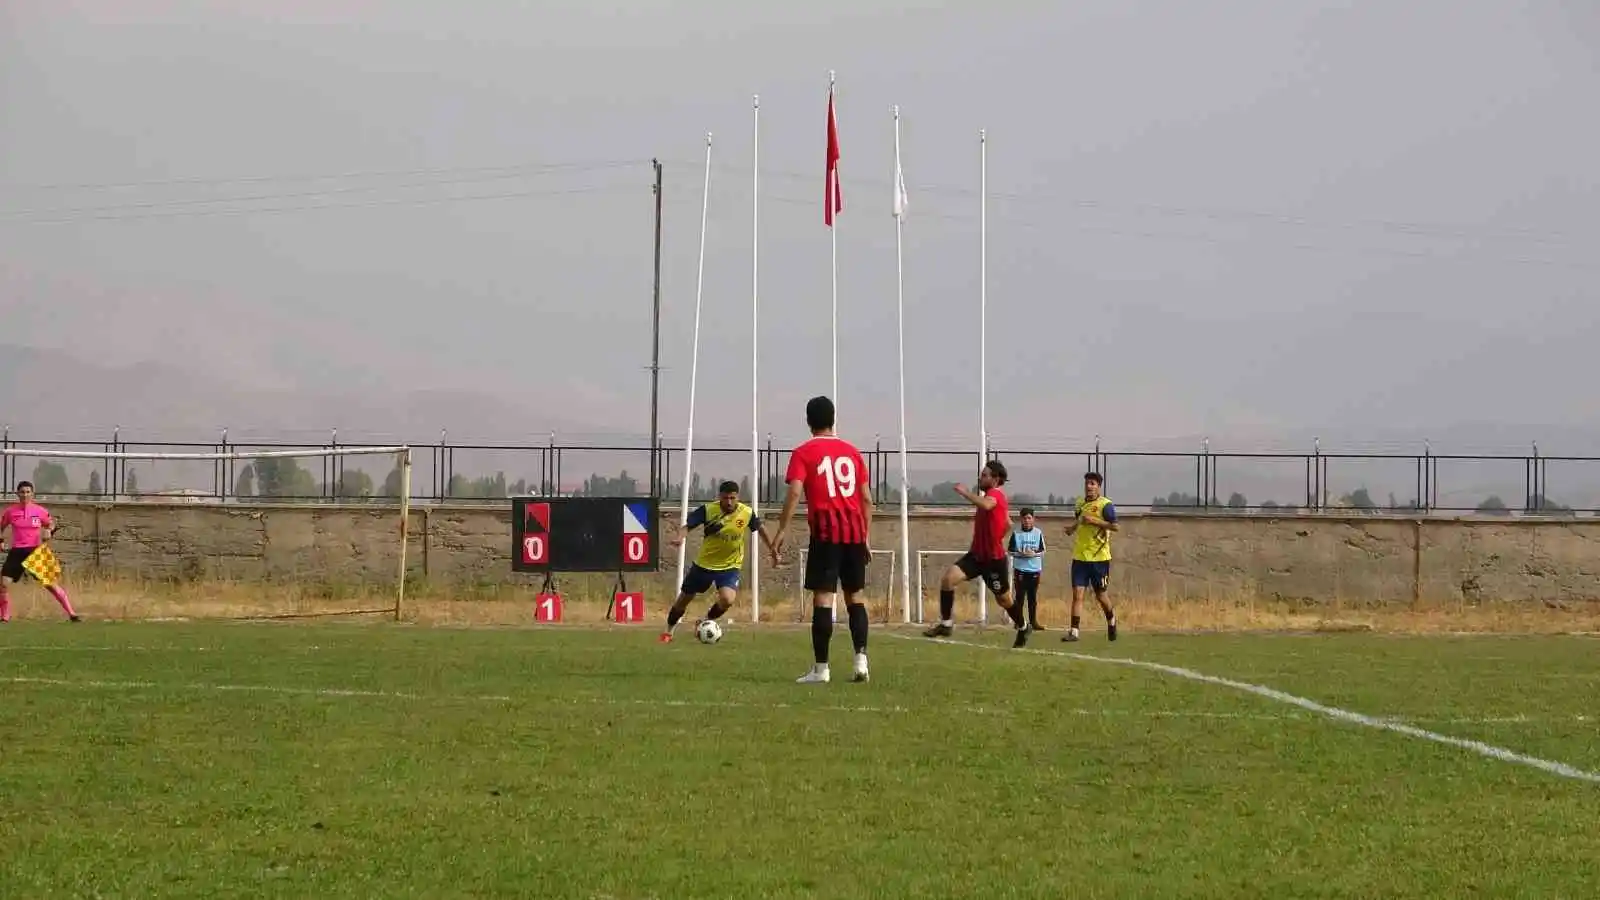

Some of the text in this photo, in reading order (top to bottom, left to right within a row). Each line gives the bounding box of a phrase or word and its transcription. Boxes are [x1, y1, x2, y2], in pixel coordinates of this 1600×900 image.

[817, 455, 857, 498] 19
[526, 536, 543, 561] 0
[628, 536, 644, 561] 0
[542, 597, 553, 621] 1
[621, 596, 633, 620] 1
